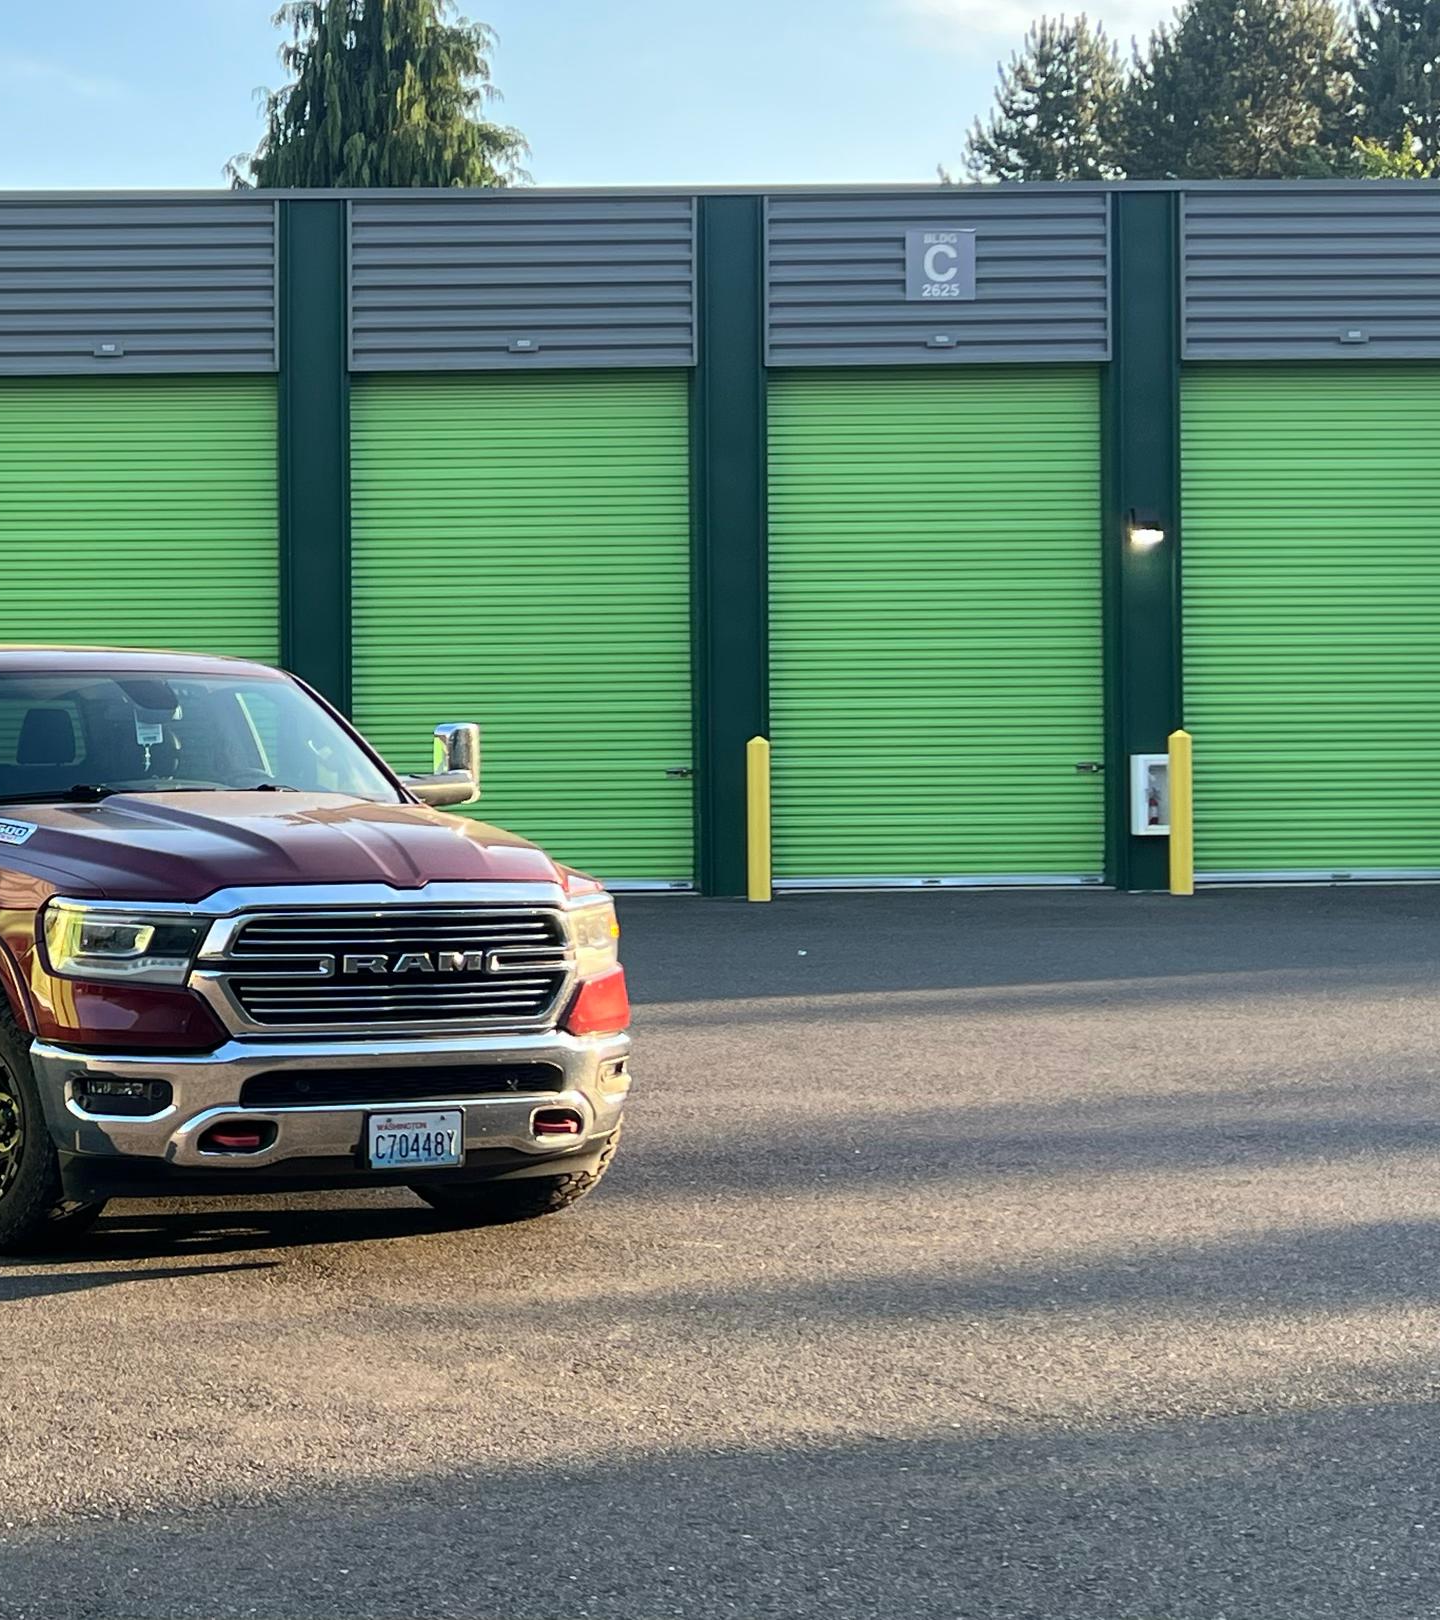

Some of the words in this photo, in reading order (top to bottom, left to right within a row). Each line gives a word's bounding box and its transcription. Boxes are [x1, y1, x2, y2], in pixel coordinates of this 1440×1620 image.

[923, 244, 958, 282] C
[922, 283, 960, 297] 2625
[343, 950, 483, 974] RAM
[376, 1121, 428, 1131] WASHINGTON
[375, 1129, 458, 1160] C70448Y
